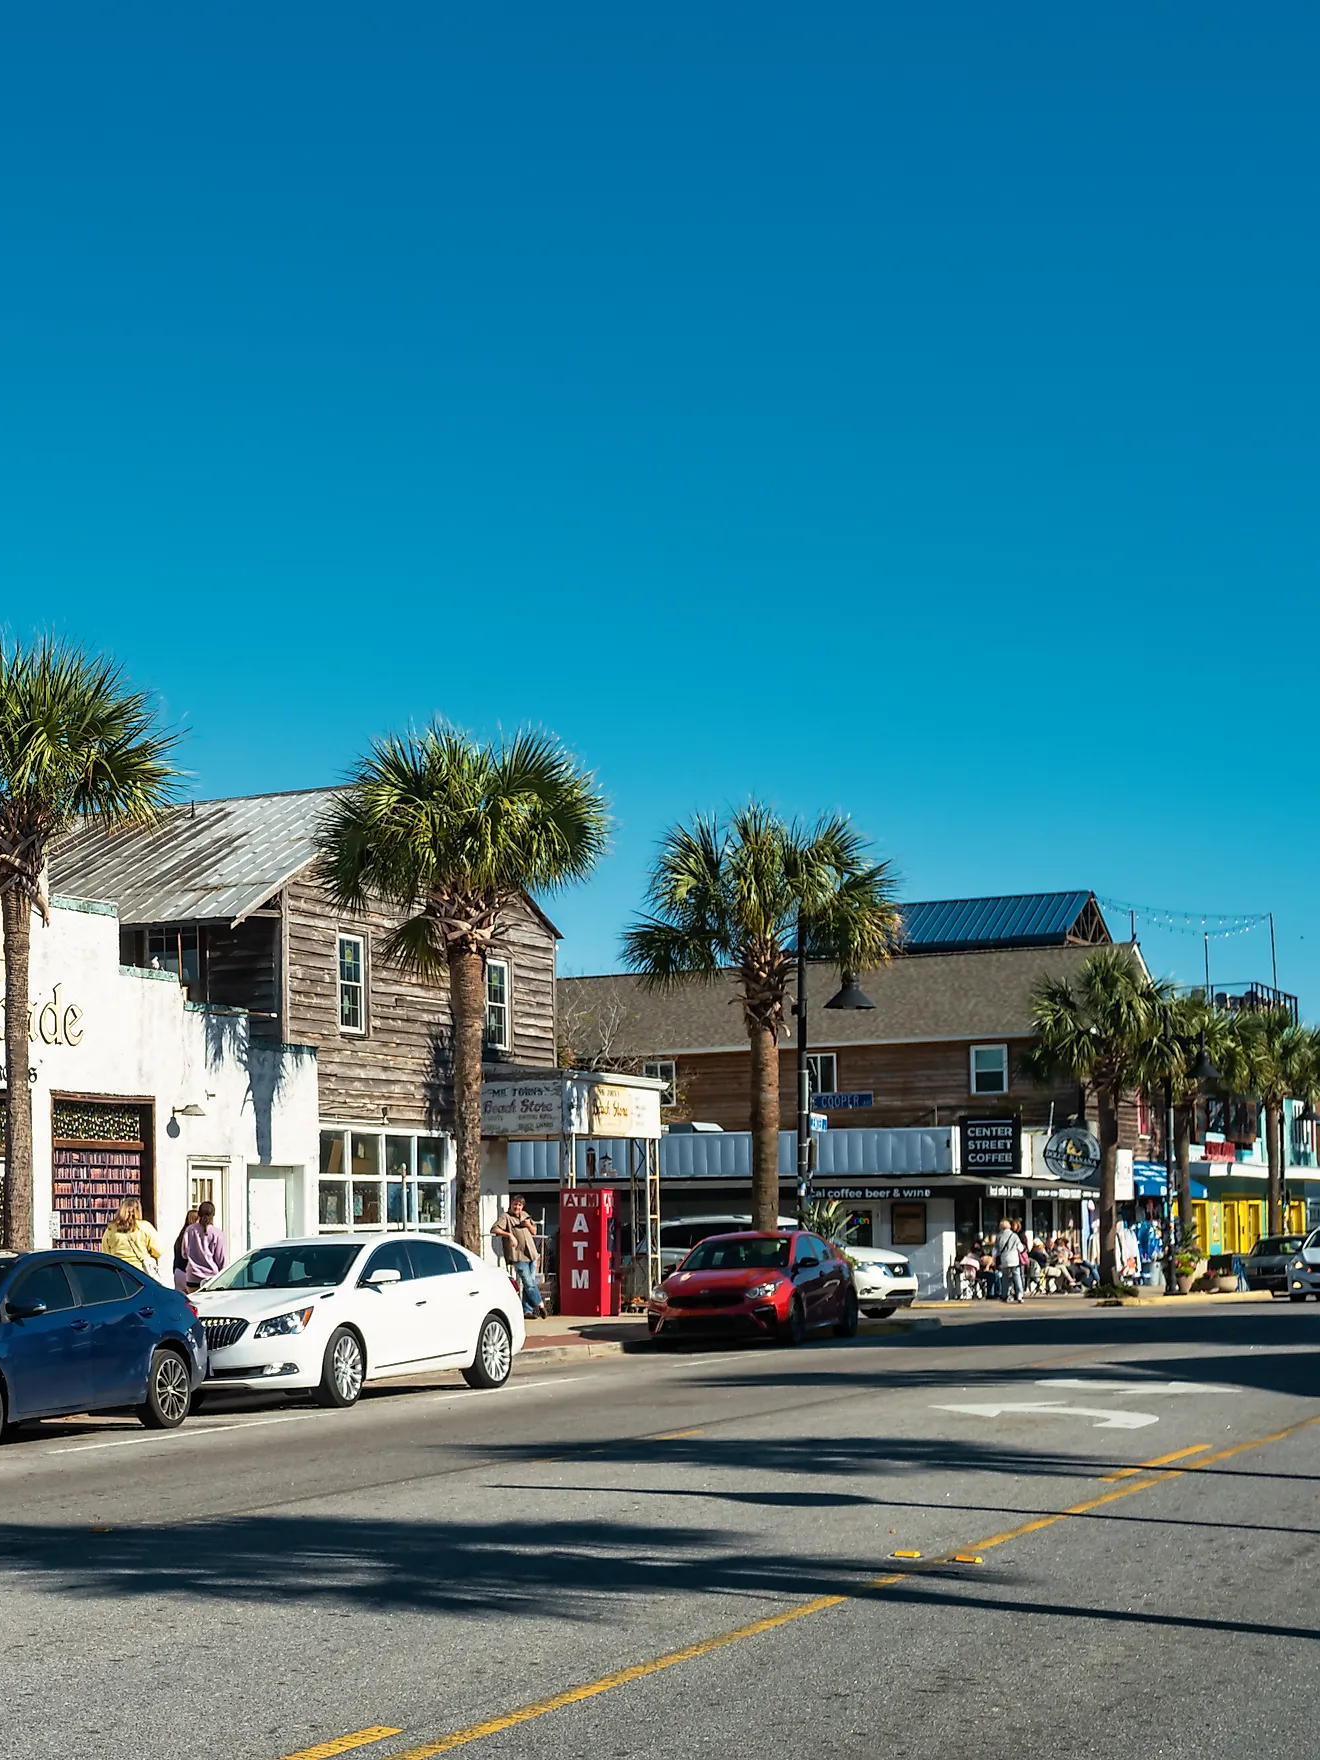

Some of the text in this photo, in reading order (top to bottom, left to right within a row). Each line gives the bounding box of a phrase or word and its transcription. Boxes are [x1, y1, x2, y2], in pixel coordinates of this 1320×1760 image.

[484, 1100, 553, 1114] Beach Store
[821, 1095, 860, 1108] COOPER
[967, 1126, 1012, 1137] CENTER
[968, 1139, 1012, 1149] STREET
[968, 1152, 1012, 1163] COFFEE
[827, 1188, 862, 1198] coffee
[865, 1188, 891, 1198] beer
[893, 1188, 900, 1197] &
[903, 1188, 931, 1197] wine
[563, 1193, 599, 1207] ATM
[572, 1213, 589, 1289] ATM
